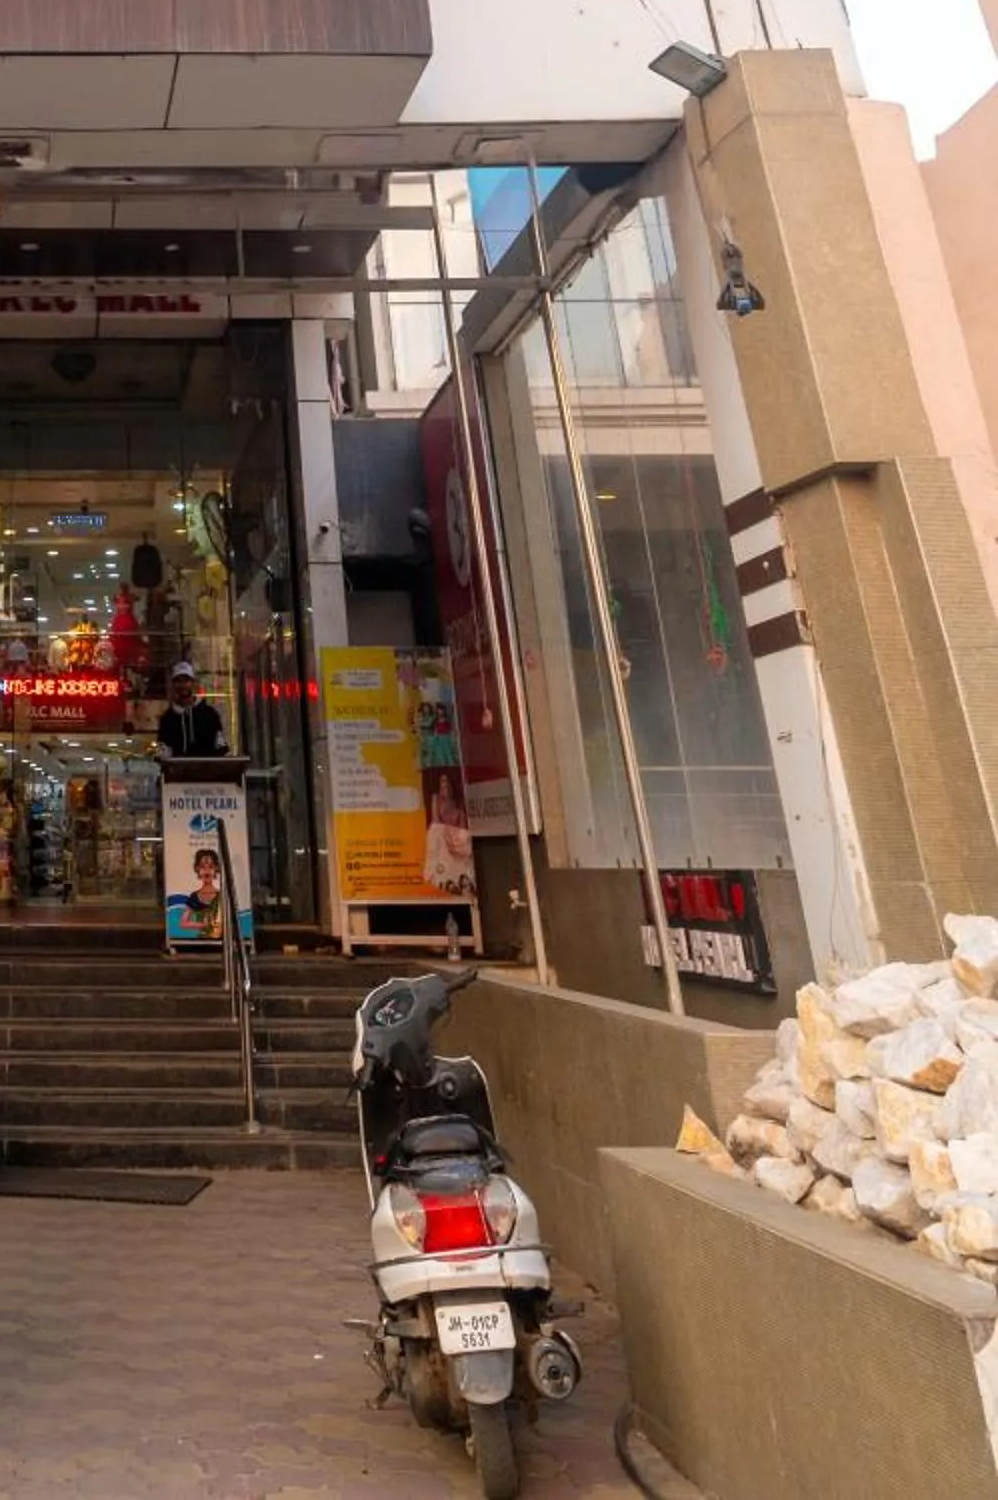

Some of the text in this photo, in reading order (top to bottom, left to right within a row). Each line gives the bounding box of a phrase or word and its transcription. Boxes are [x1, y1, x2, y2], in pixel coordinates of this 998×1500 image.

[49, 704, 87, 719] MALL
[169, 796, 238, 811] HOTEL PEARL
[460, 1331, 492, 1349] 5631
